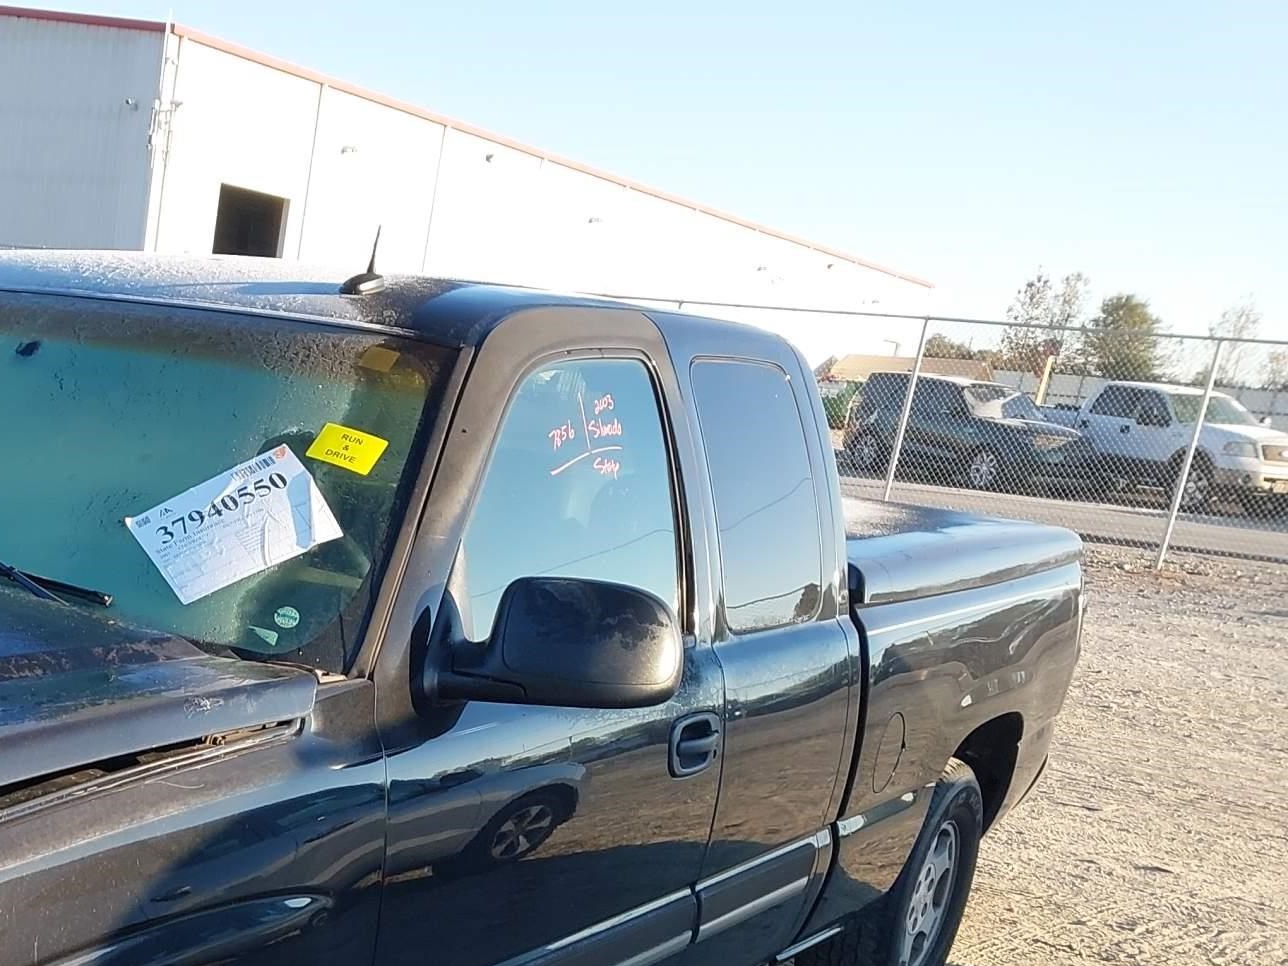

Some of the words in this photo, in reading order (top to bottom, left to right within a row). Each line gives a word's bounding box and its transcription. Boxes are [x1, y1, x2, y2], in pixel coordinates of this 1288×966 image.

[340, 433, 364, 446] RUN
[324, 448, 357, 464] DRIVE
[155, 472, 288, 545] 37940550
